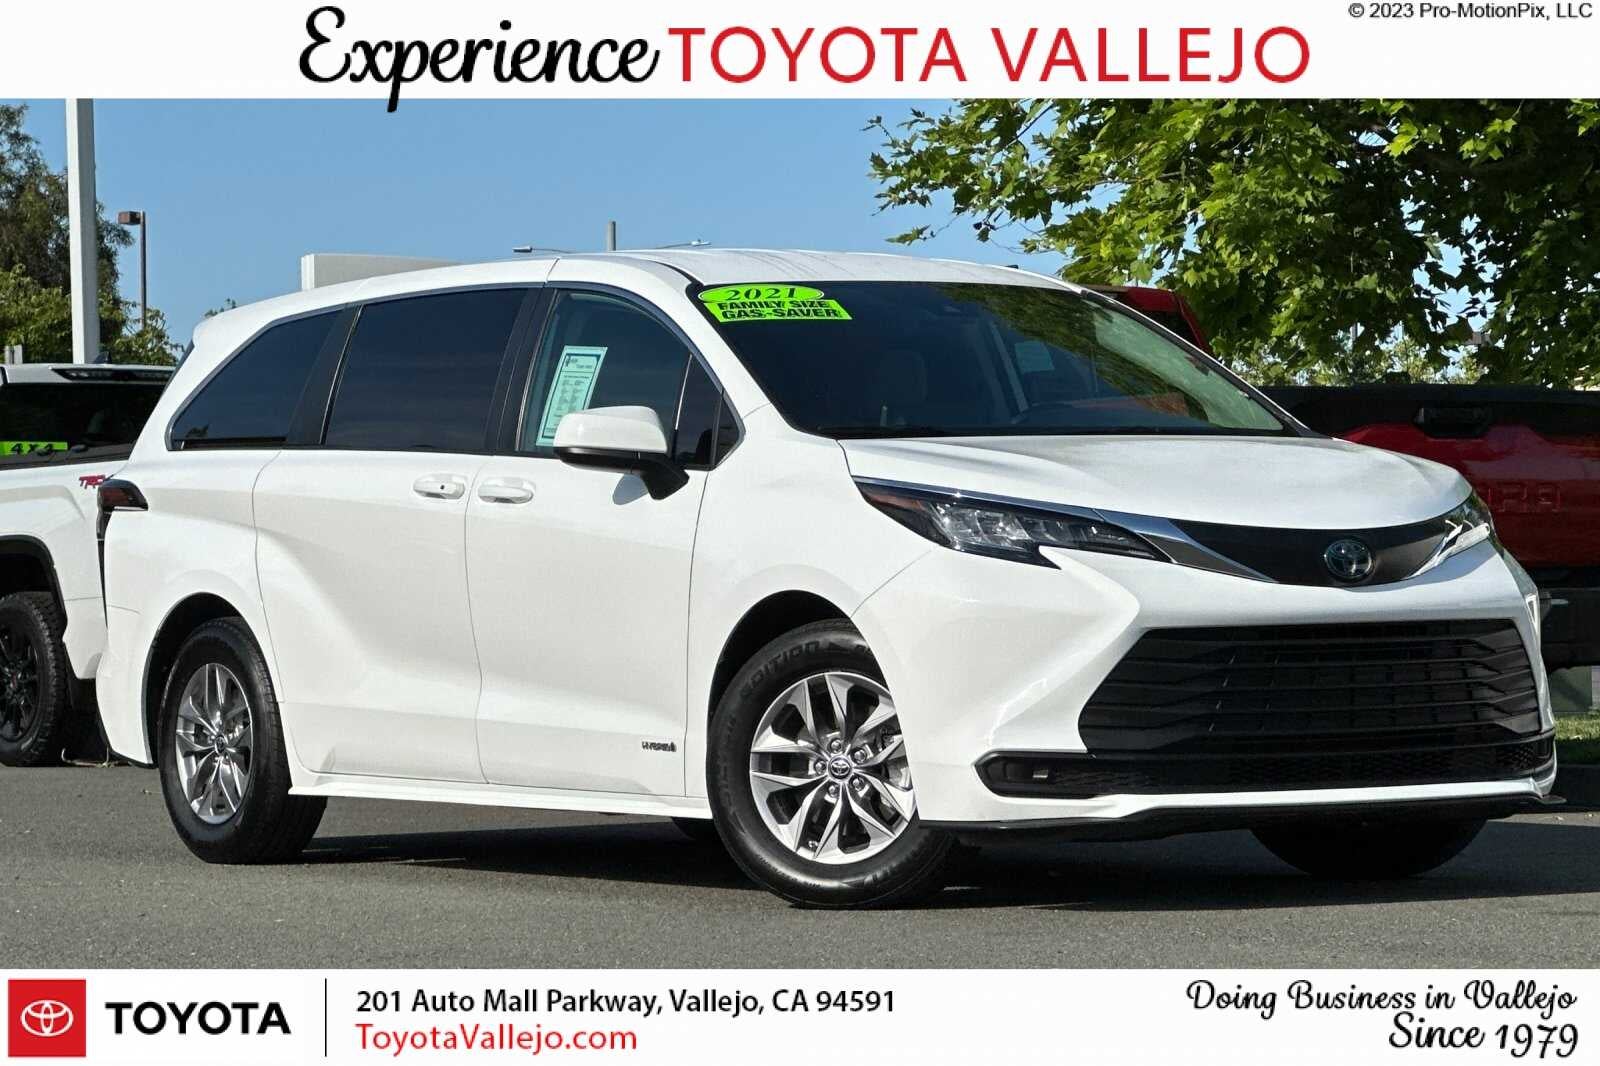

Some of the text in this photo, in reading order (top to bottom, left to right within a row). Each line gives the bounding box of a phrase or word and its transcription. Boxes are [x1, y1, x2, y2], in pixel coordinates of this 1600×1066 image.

[725, 287, 797, 301] 2021
[717, 300, 831, 310] FAMILY SIZE
[720, 308, 842, 320] GAS-SAVER
